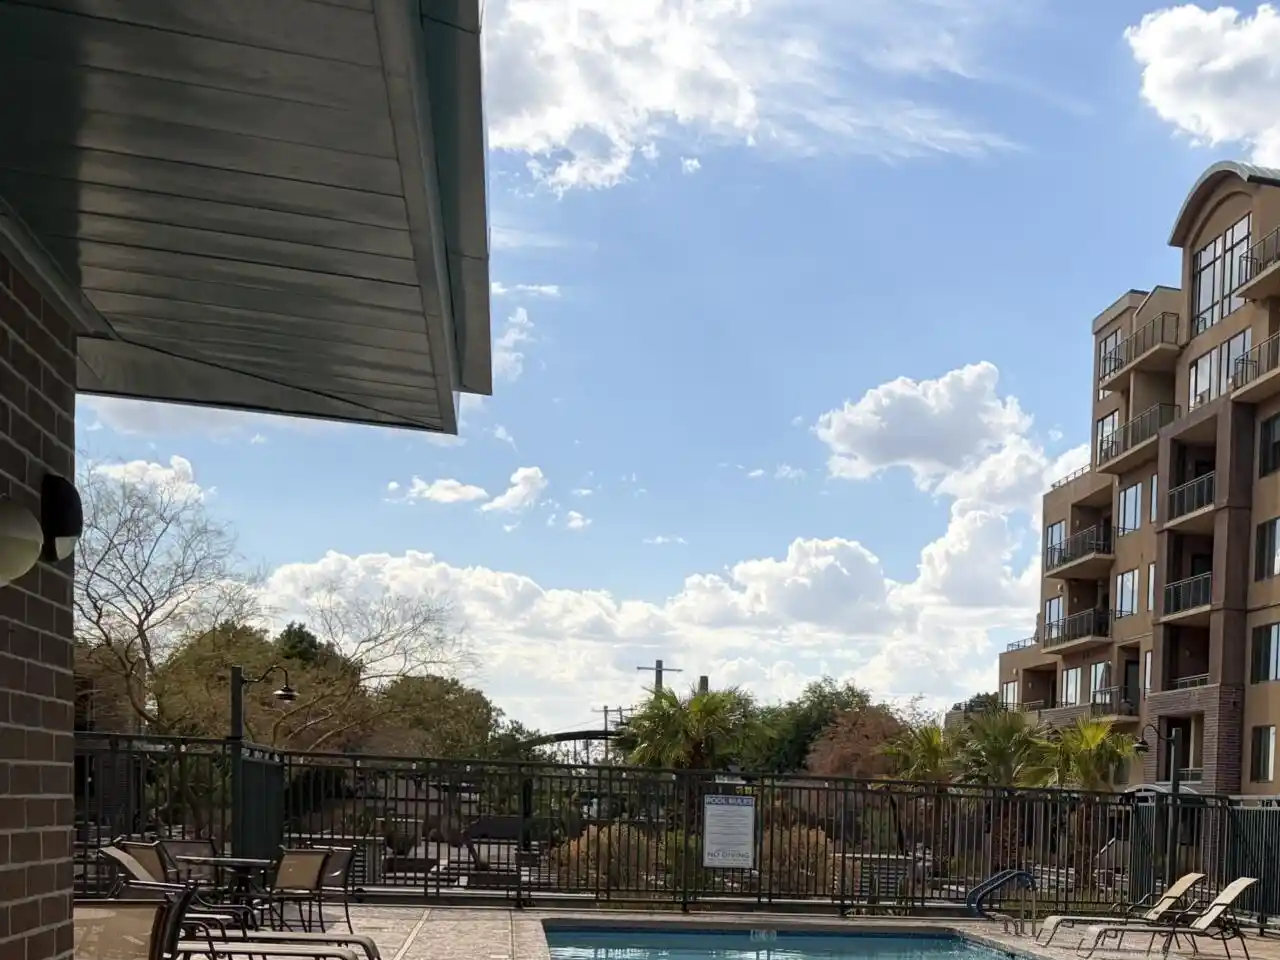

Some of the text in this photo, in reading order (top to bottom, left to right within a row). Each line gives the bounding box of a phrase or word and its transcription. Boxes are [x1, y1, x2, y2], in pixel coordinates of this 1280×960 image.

[706, 797, 753, 806] POOL RULES
[721, 851, 750, 859] DIVING
